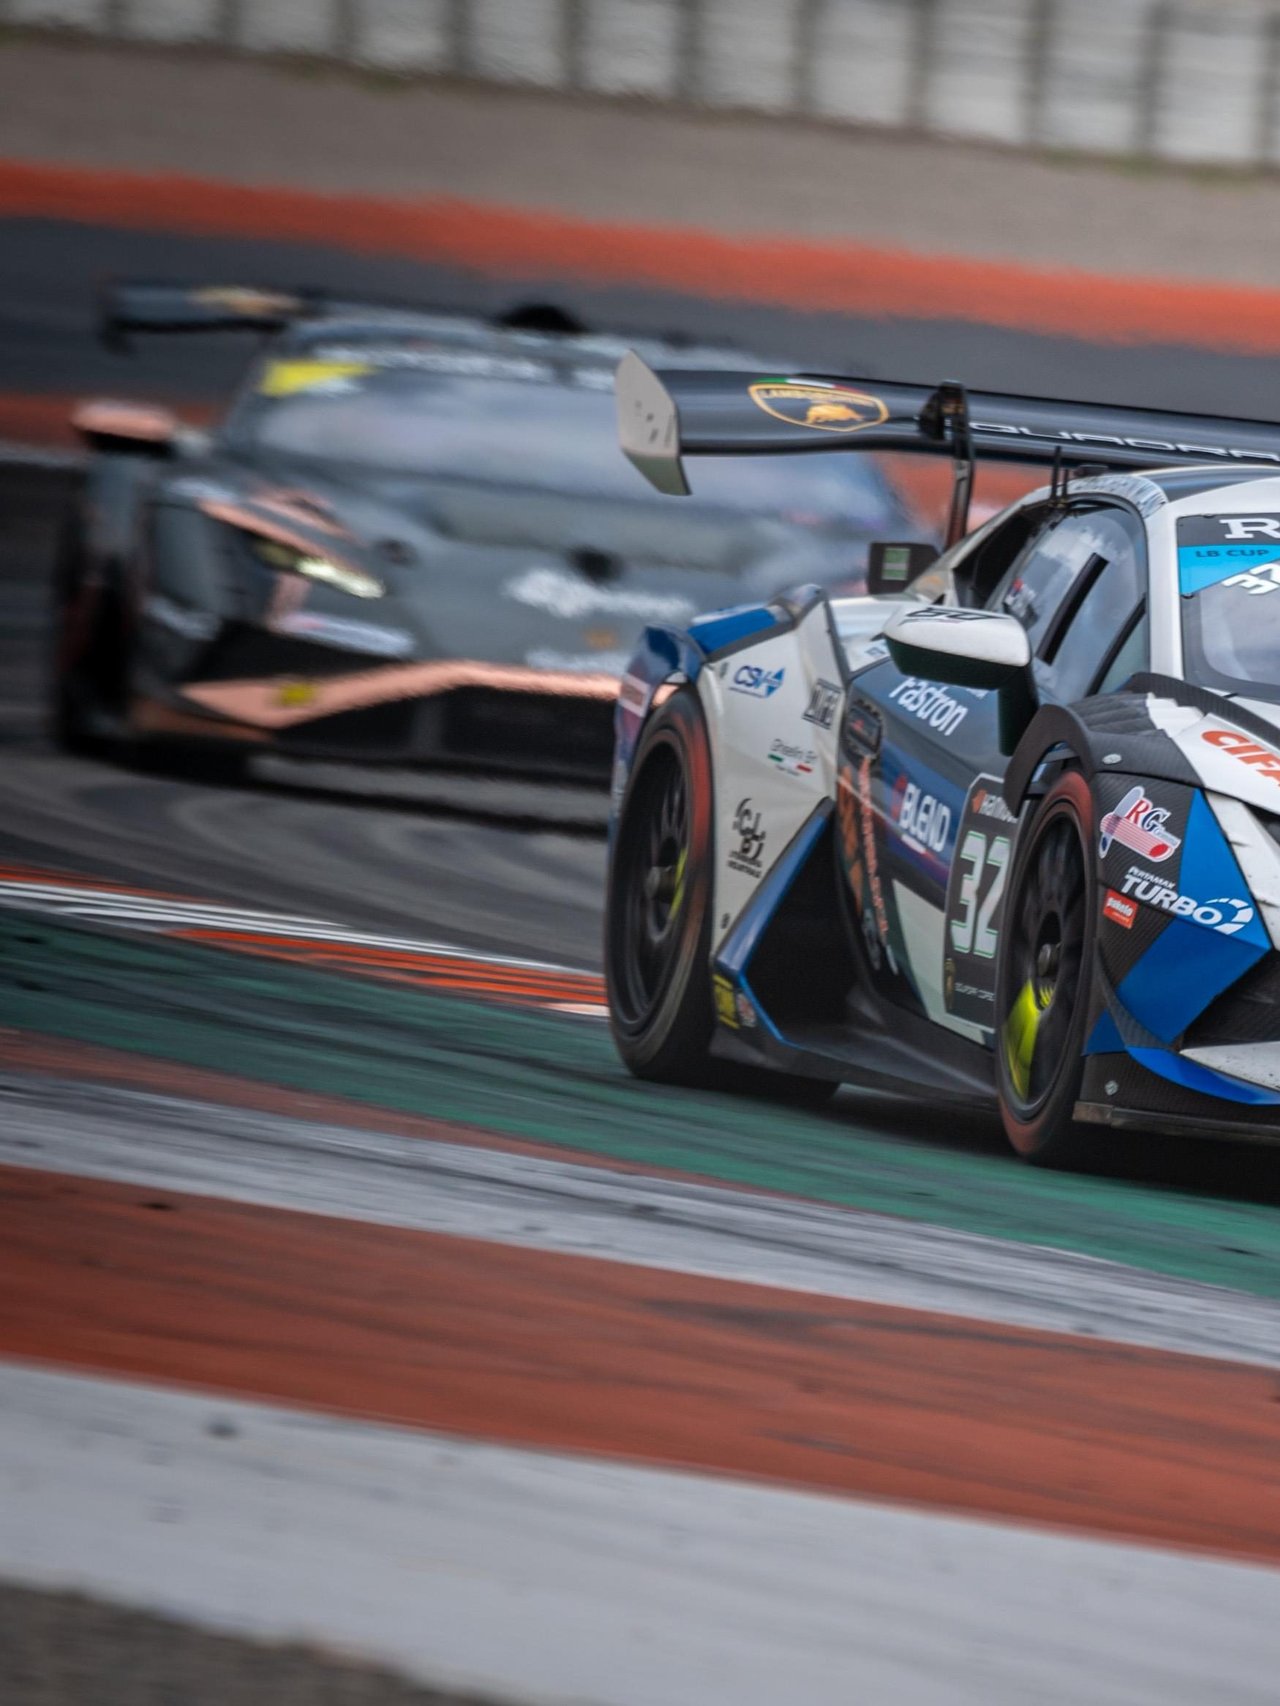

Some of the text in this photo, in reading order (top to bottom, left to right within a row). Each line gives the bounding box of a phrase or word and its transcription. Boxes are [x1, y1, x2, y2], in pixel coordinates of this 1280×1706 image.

[1195, 548, 1270, 558] LB CUP
[902, 782, 950, 853] BLEND
[1126, 799, 1173, 832] RG
[951, 831, 1011, 959] 32
[1128, 866, 1176, 889] PERTAMAX
[1121, 874, 1223, 925] TURBO
